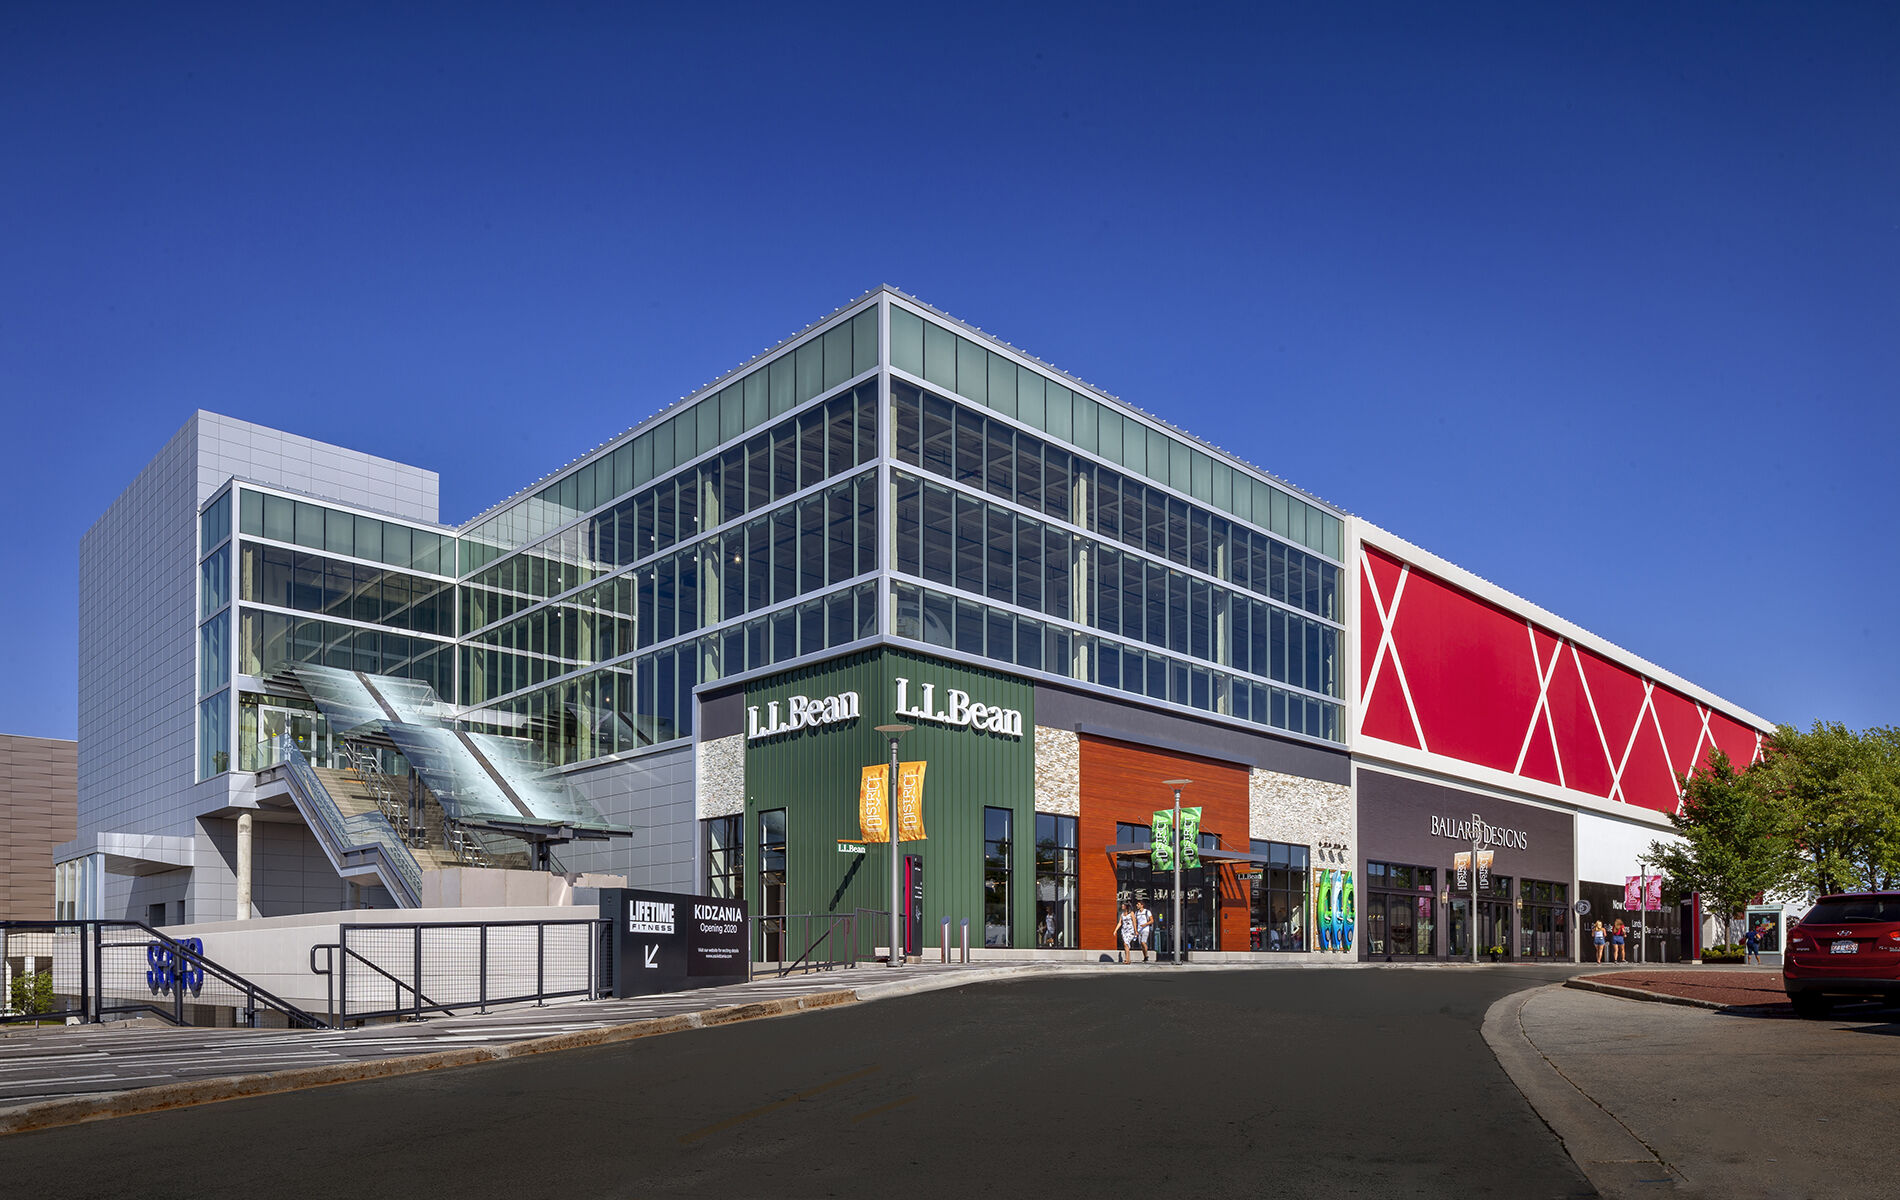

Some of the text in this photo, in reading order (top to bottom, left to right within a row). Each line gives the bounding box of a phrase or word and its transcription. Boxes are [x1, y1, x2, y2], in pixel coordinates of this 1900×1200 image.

[866, 776, 882, 827] DISTRICT
[903, 773, 919, 824] DISTRICT
[1431, 815, 1527, 850] BALLARD DESIGNS
[629, 900, 675, 923] LIFETIME
[694, 904, 743, 922] KIDZANIA
[631, 924, 673, 932] FITNESS
[700, 922, 738, 934] Opening 2020
